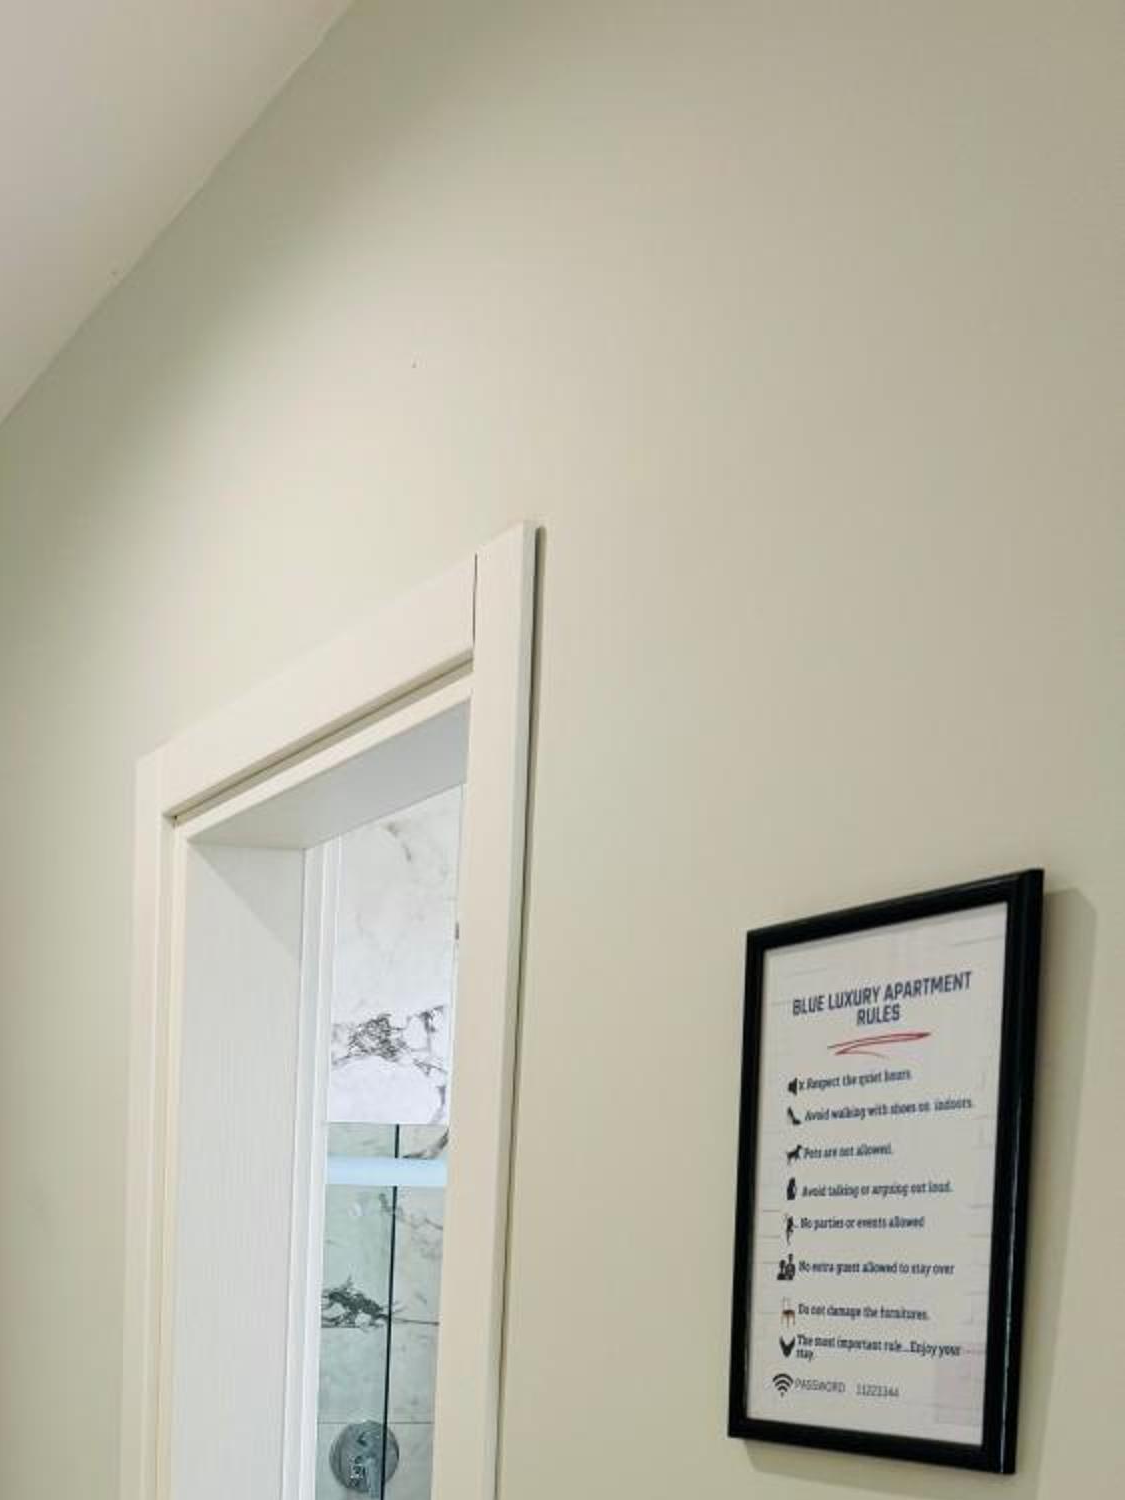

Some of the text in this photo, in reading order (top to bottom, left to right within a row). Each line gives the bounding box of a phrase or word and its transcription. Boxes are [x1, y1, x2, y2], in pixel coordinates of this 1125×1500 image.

[792, 972, 972, 1015] BLUE LUXURY APARTMENT
[857, 1004, 900, 1025] RULES
[804, 1108, 830, 1121] Avoid
[831, 1105, 866, 1120] walking
[868, 1103, 888, 1116] with
[800, 1217, 813, 1229] No
[814, 1217, 844, 1231] parties
[857, 1217, 887, 1229] events
[798, 1261, 811, 1272] No
[861, 1260, 898, 1274] allowed
